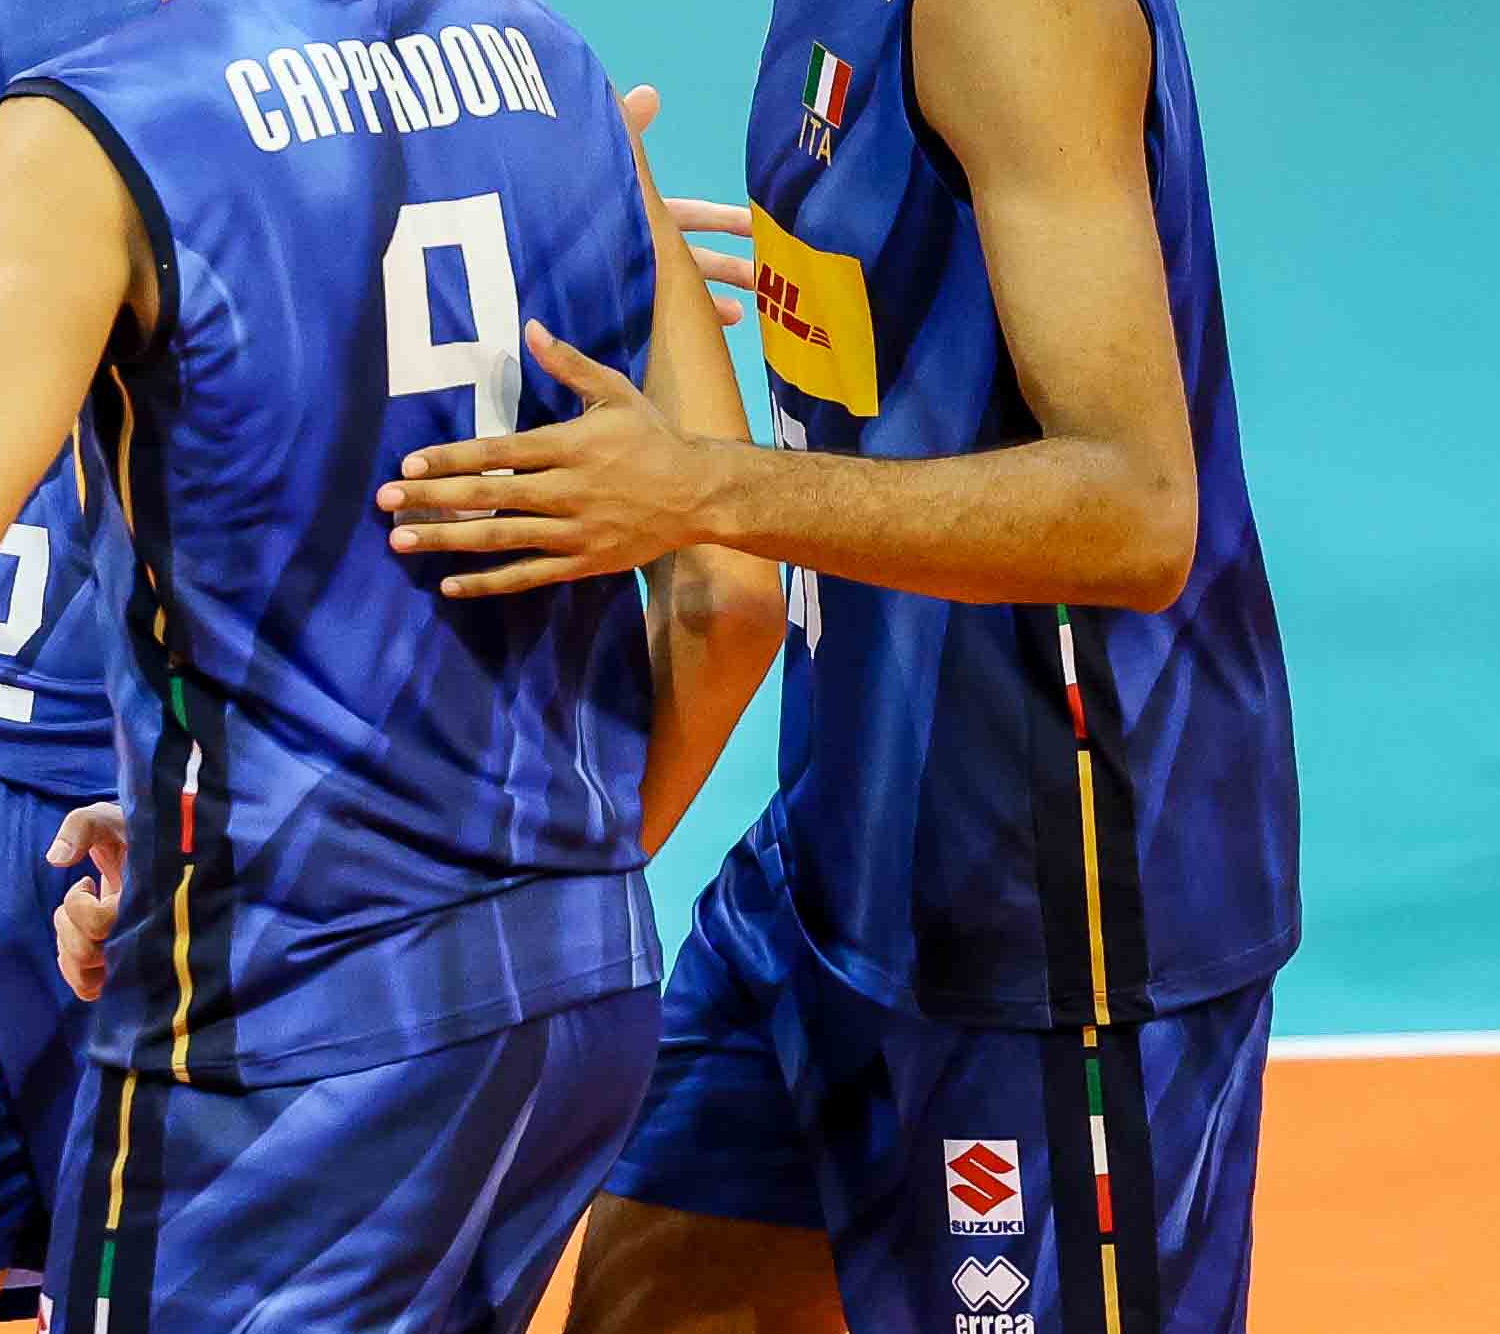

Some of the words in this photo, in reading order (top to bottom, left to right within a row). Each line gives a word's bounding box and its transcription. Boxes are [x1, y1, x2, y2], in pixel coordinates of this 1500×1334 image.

[224, 23, 558, 153] CAPPADONA
[798, 111, 832, 167] ITA
[756, 263, 811, 342] HL
[383, 192, 522, 524] 9
[951, 1220, 1023, 1234] SUZUKI
